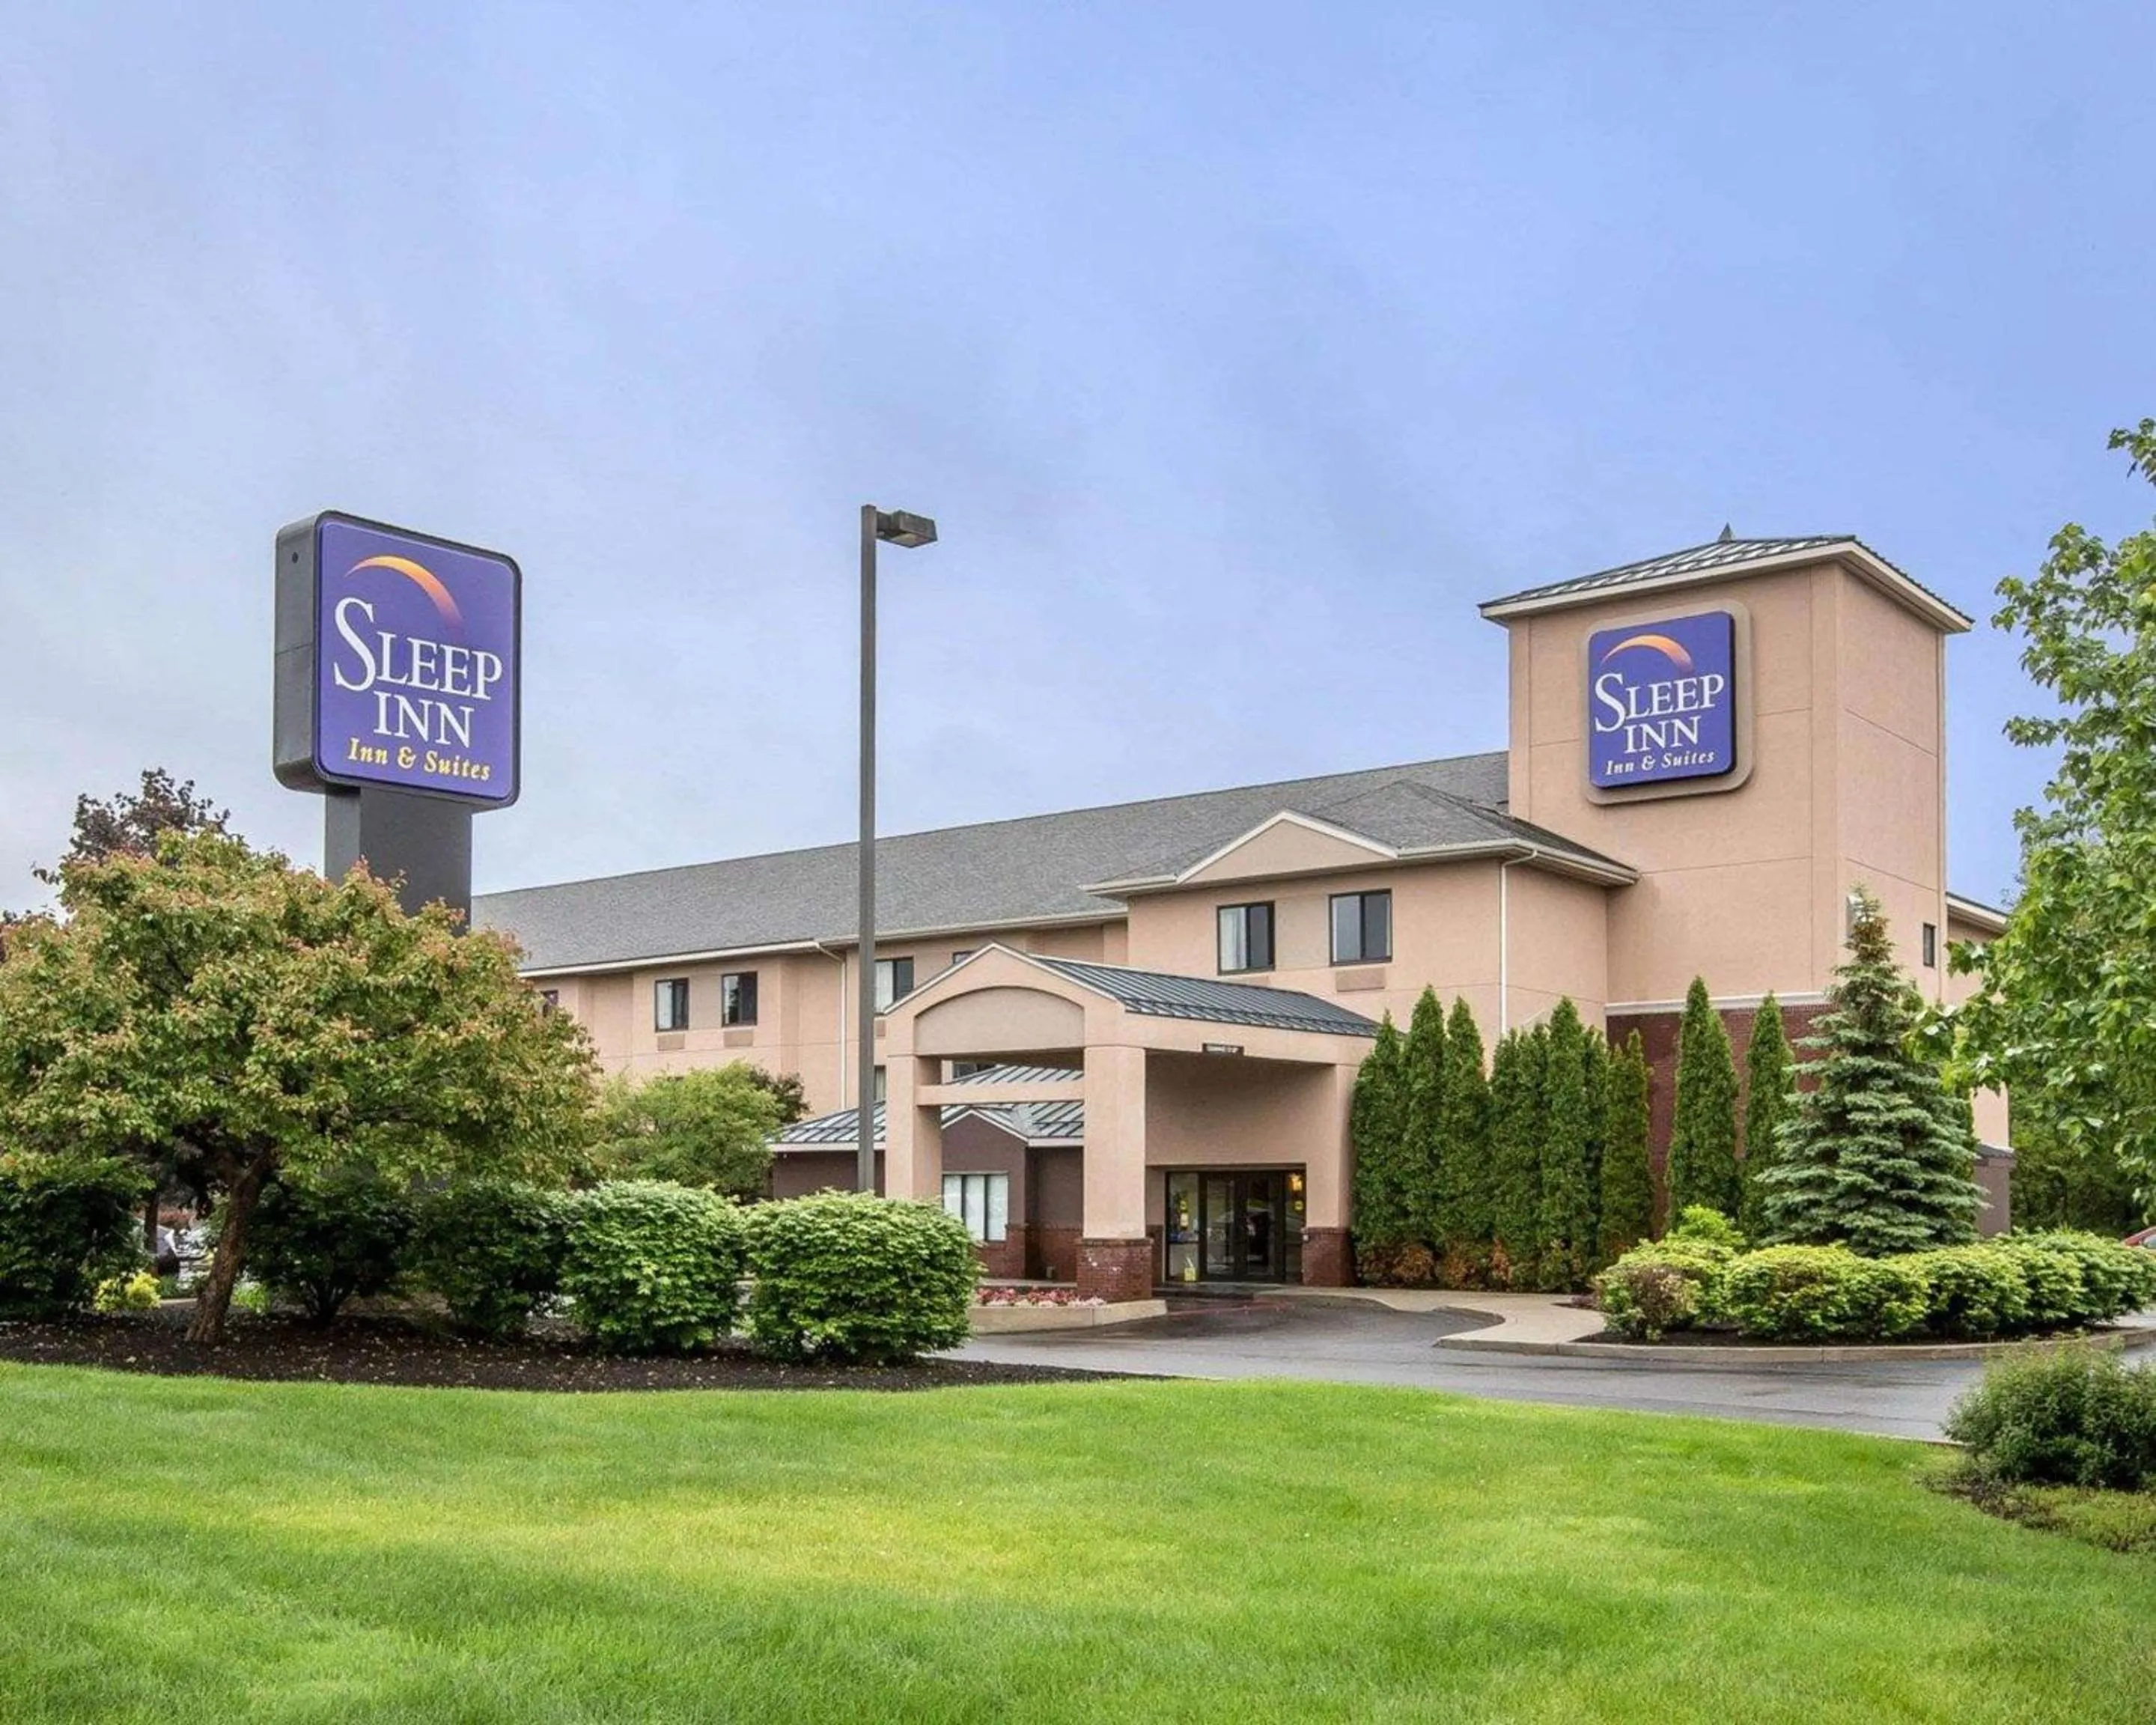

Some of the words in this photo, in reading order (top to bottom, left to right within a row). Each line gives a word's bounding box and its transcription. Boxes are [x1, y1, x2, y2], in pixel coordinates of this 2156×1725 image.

[333, 597, 503, 701] SLEEP
[373, 690, 475, 749] INN
[1595, 672, 1725, 732] SLEEP
[347, 737, 388, 764] Inn
[397, 746, 416, 770] &
[424, 750, 491, 782] Suites
[1624, 715, 1702, 754] INN
[1605, 760, 1634, 776] Inn
[1641, 754, 1656, 771] &
[1661, 750, 1715, 768] Suites
